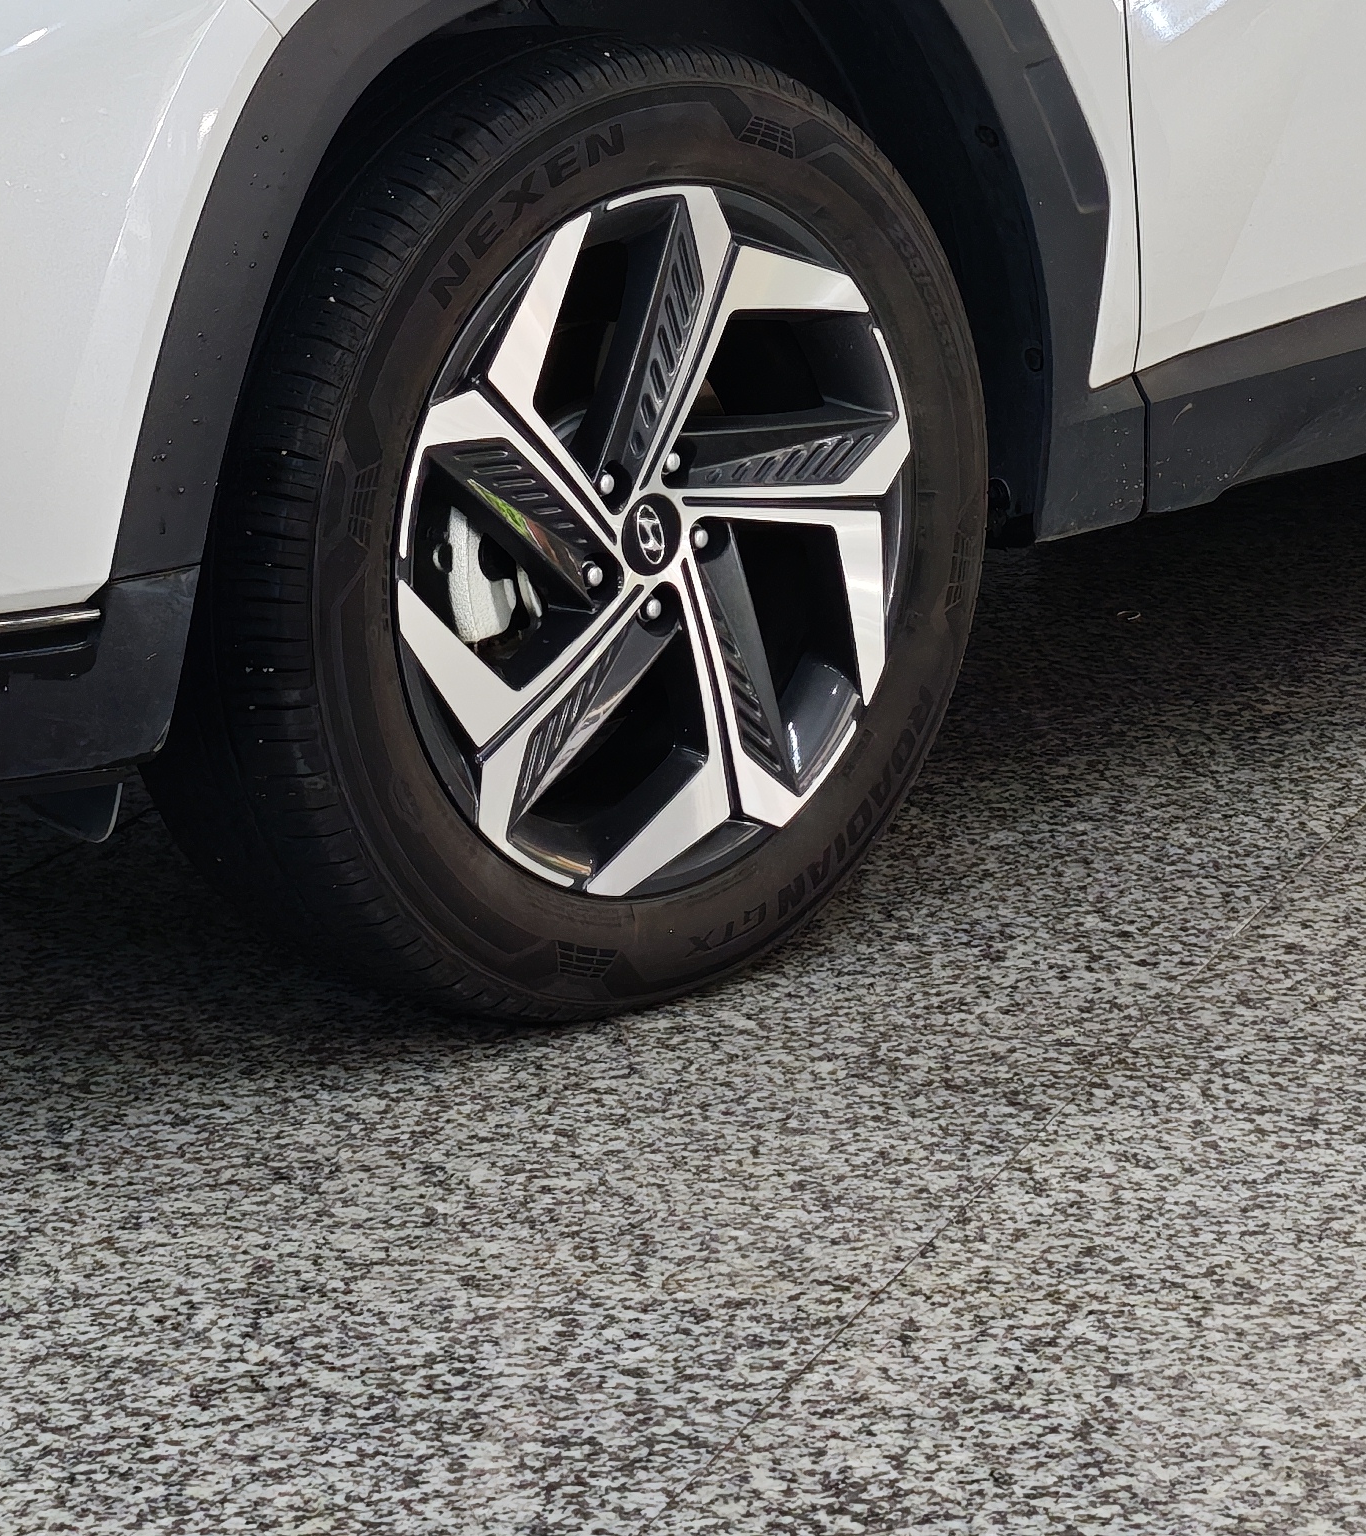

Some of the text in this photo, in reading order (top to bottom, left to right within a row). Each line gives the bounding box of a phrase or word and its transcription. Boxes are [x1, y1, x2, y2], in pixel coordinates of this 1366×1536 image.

[428, 122, 626, 311] NEXEN
[684, 684, 934, 958] ROADIAN GTX
